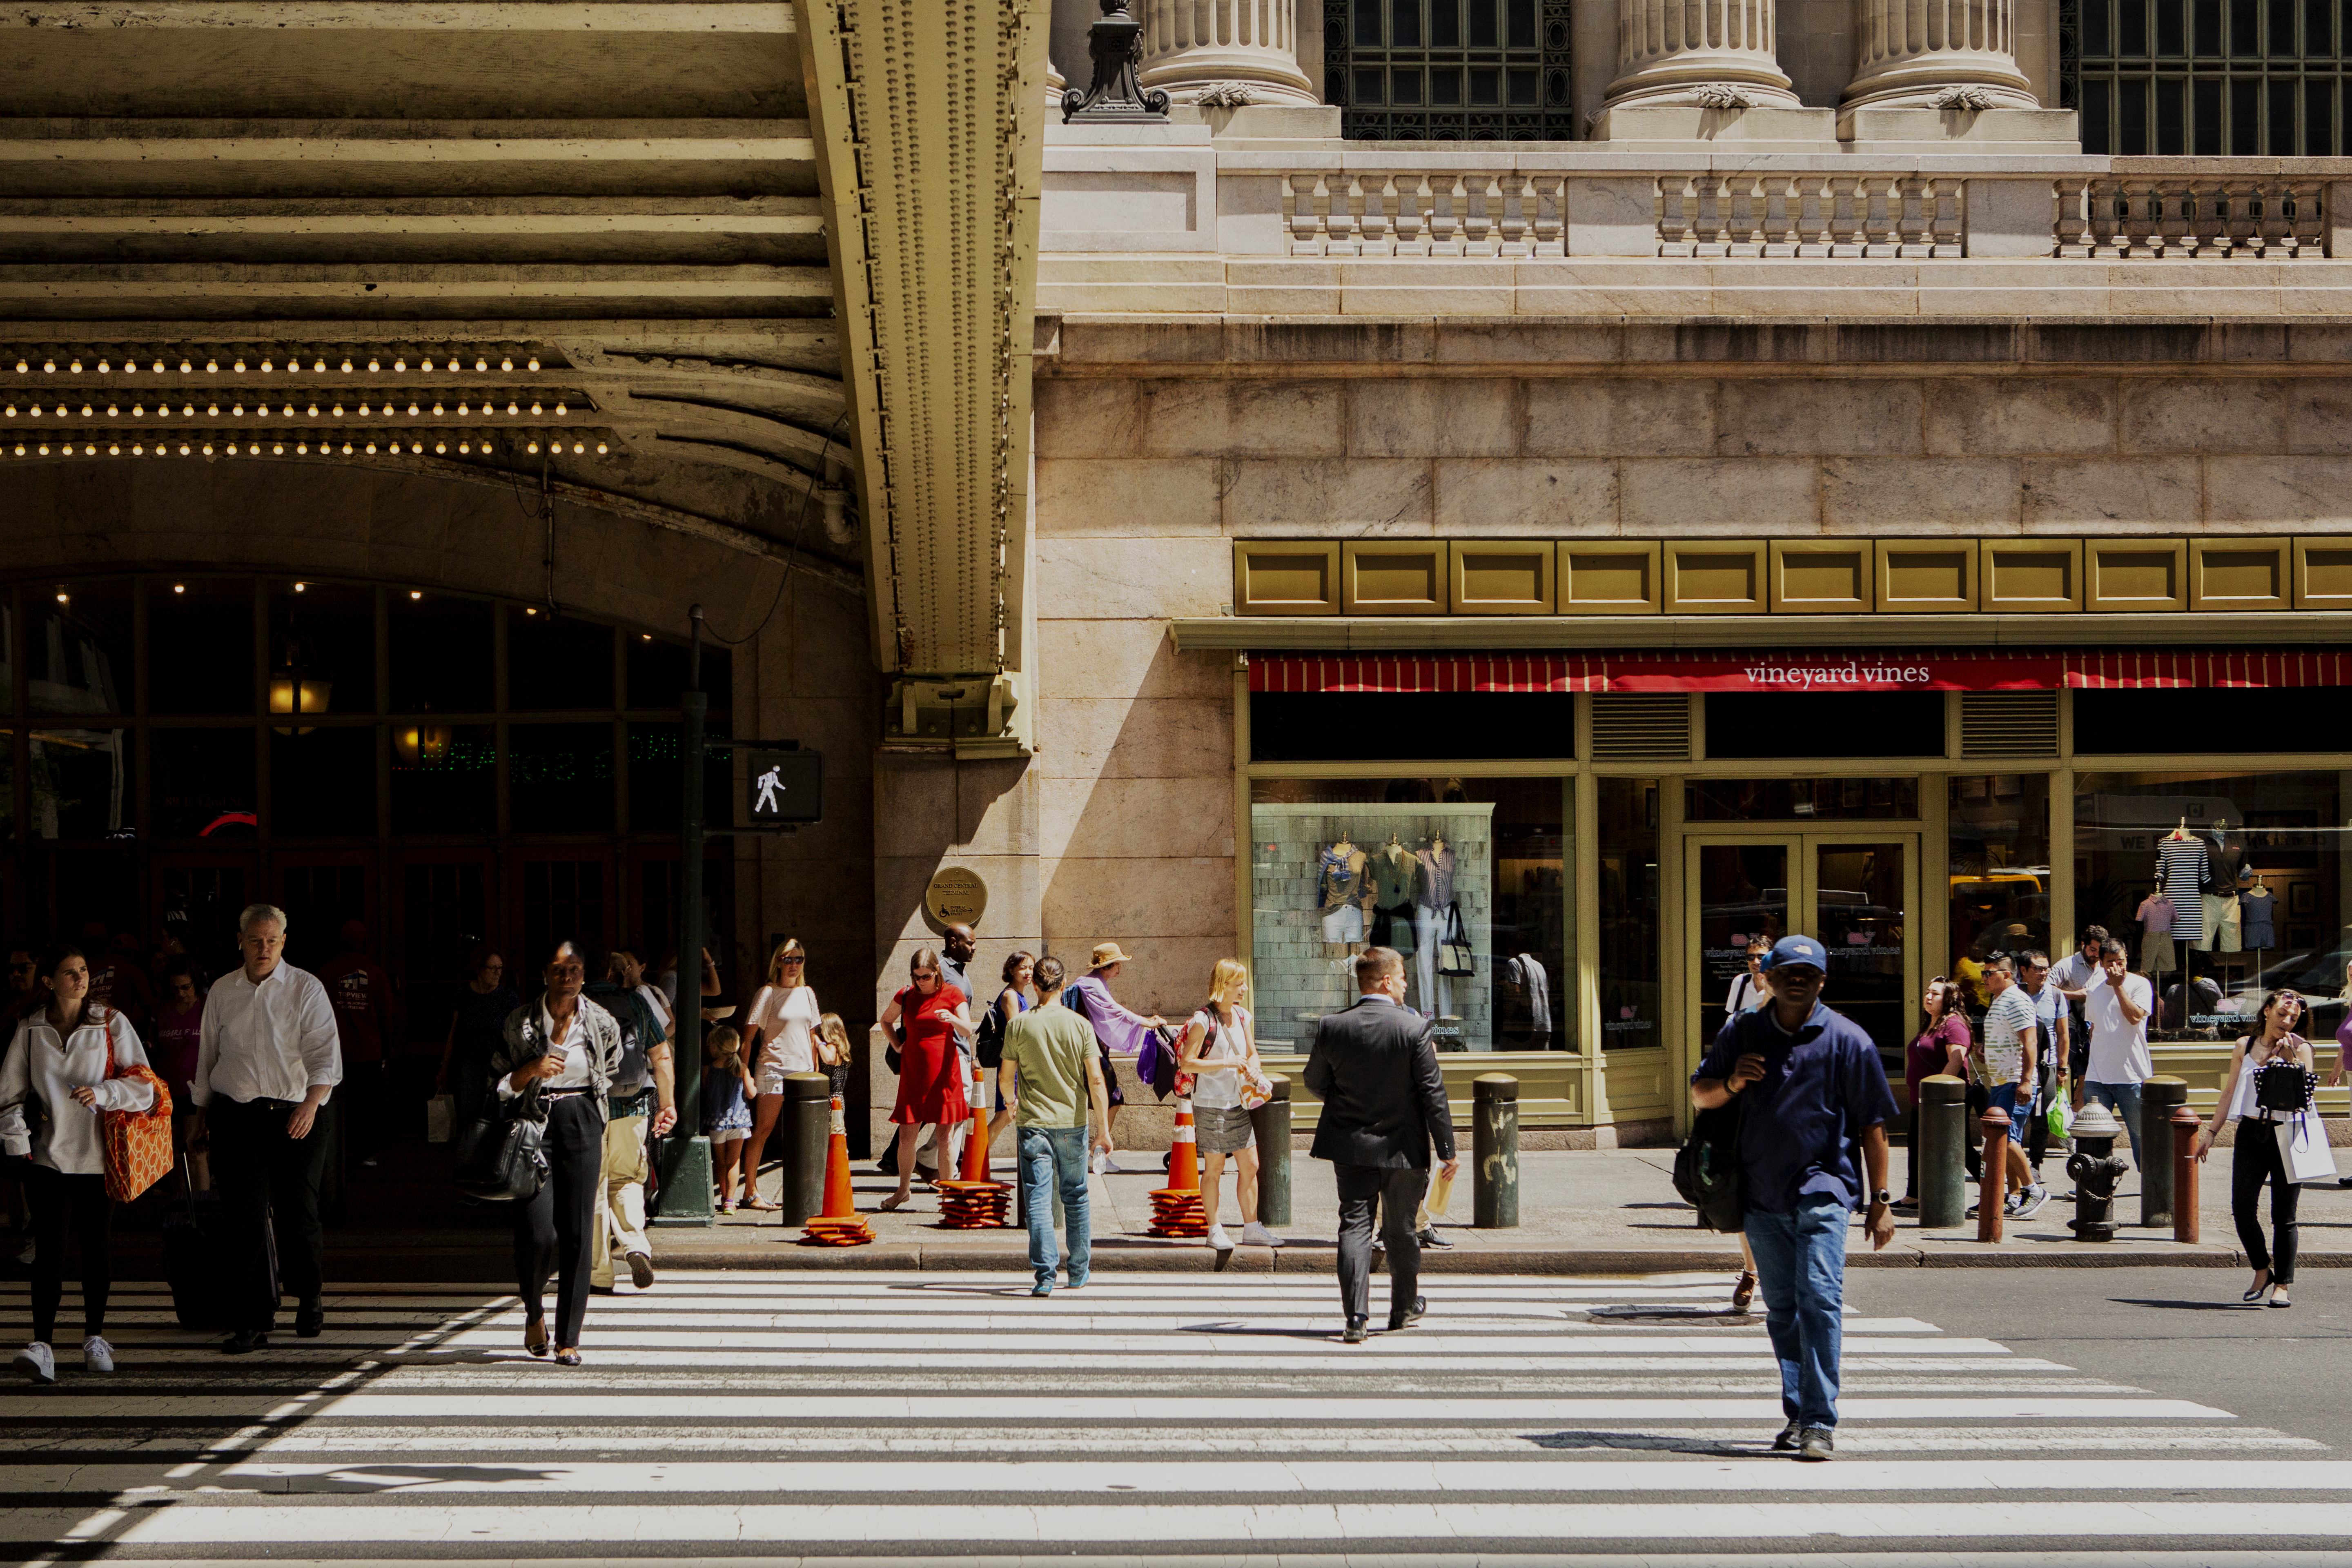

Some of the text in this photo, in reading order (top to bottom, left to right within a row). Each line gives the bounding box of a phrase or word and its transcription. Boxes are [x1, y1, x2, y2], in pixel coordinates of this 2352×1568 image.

[1744, 662, 1929, 690] vineyard vines
[164, 795, 180, 807] 89
[183, 795, 192, 807] E
[196, 795, 227, 807] 42nd
[1704, 947, 1746, 960] vineyar
[1825, 944, 1901, 958] ineyard vines
[2189, 1011, 2258, 1026] vineyard vin
